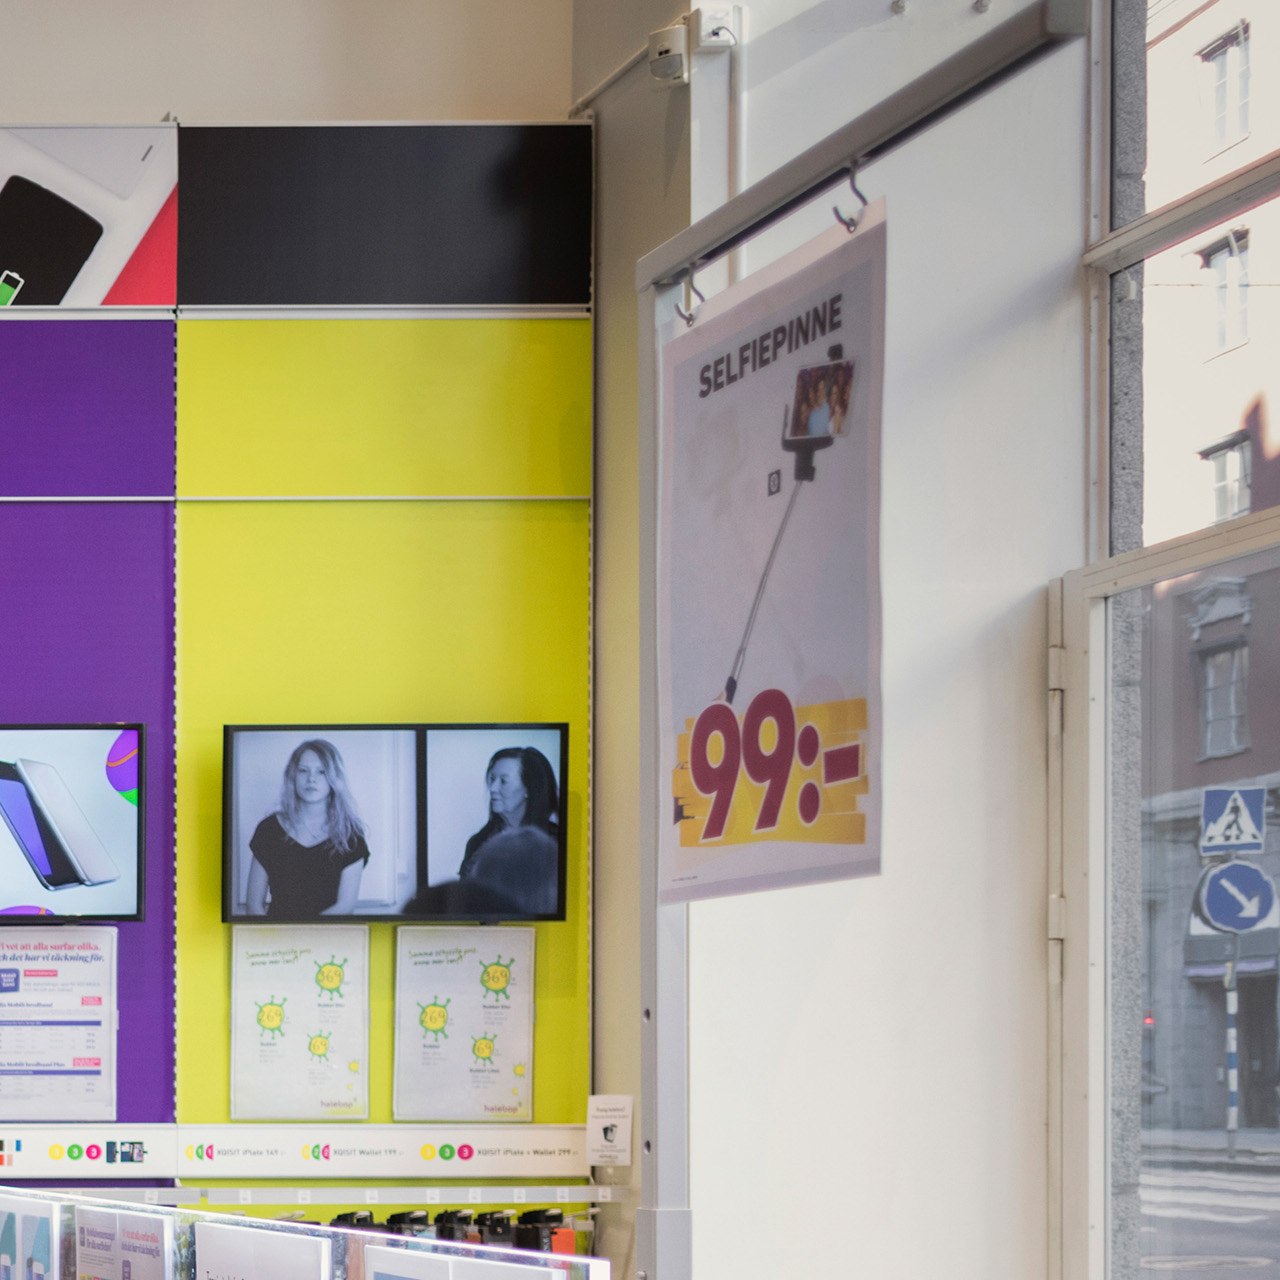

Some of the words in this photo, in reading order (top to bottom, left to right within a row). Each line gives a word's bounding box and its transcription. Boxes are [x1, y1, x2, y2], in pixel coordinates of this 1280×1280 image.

[698, 294, 842, 400] SELFIEPINNE
[690, 688, 860, 841] 99:-
[317, 970, 342, 986] 369
[484, 970, 508, 986] 369
[258, 1008, 282, 1025] 269
[422, 1010, 447, 1026] 269
[484, 1104, 518, 1114] halebop
